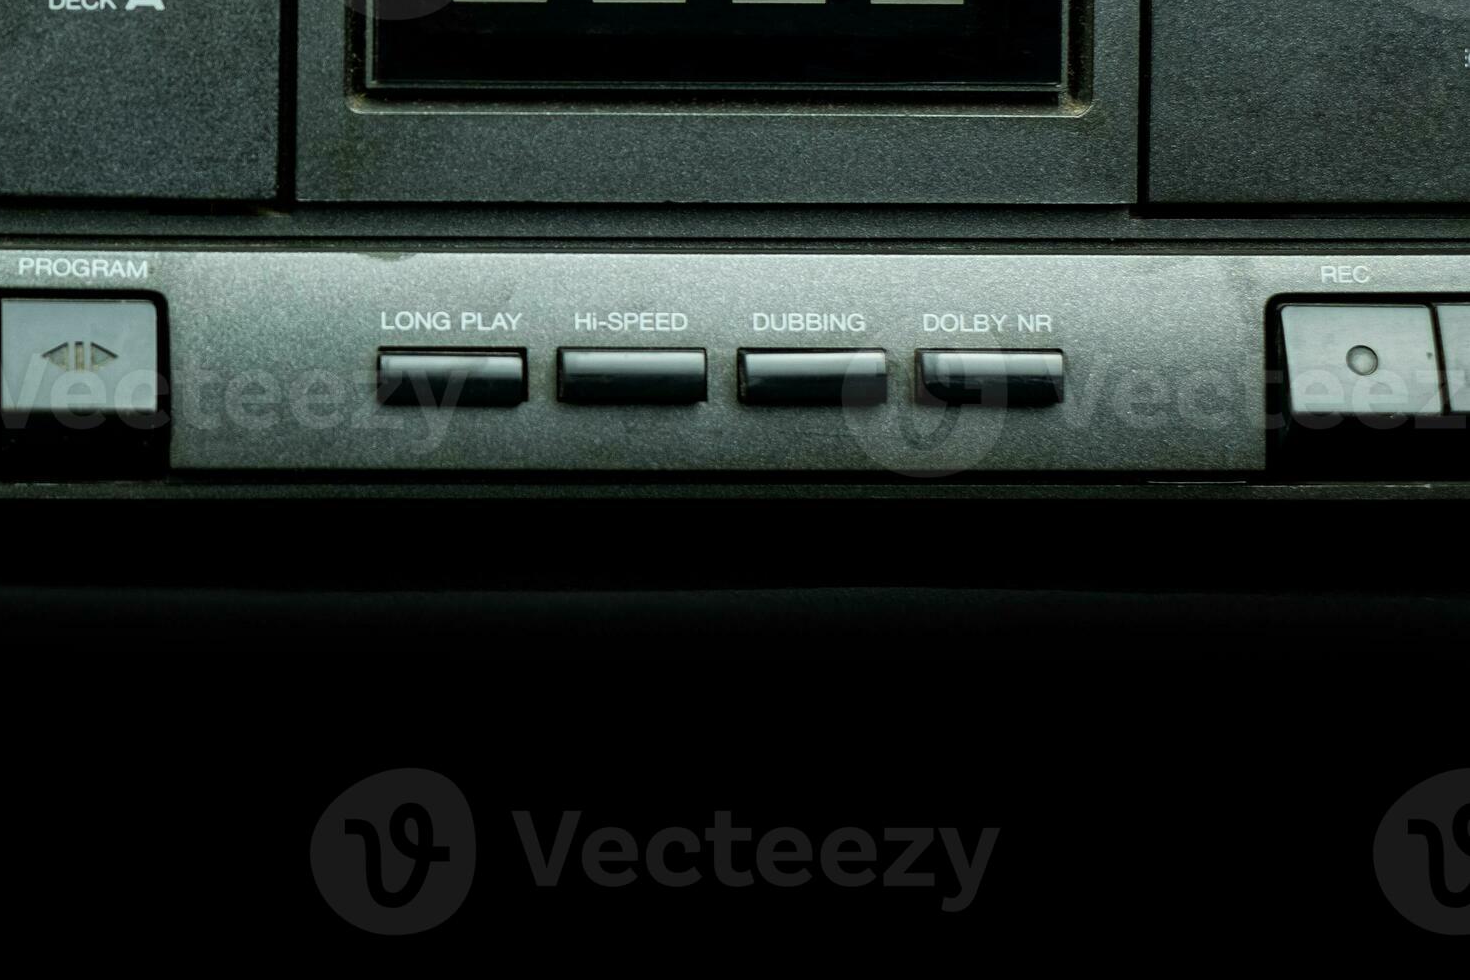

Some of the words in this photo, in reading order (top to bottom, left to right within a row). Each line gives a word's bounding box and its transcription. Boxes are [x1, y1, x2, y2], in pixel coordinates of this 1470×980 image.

[18, 256, 148, 279] PROGRAM
[1321, 265, 1370, 284] REC
[381, 311, 450, 331] LONG
[460, 312, 522, 331] PLAY
[574, 312, 689, 331] Hi-SPEED
[752, 312, 866, 332] DUBBING
[923, 313, 1008, 333] DOLBY
[1018, 314, 1052, 333] NR
